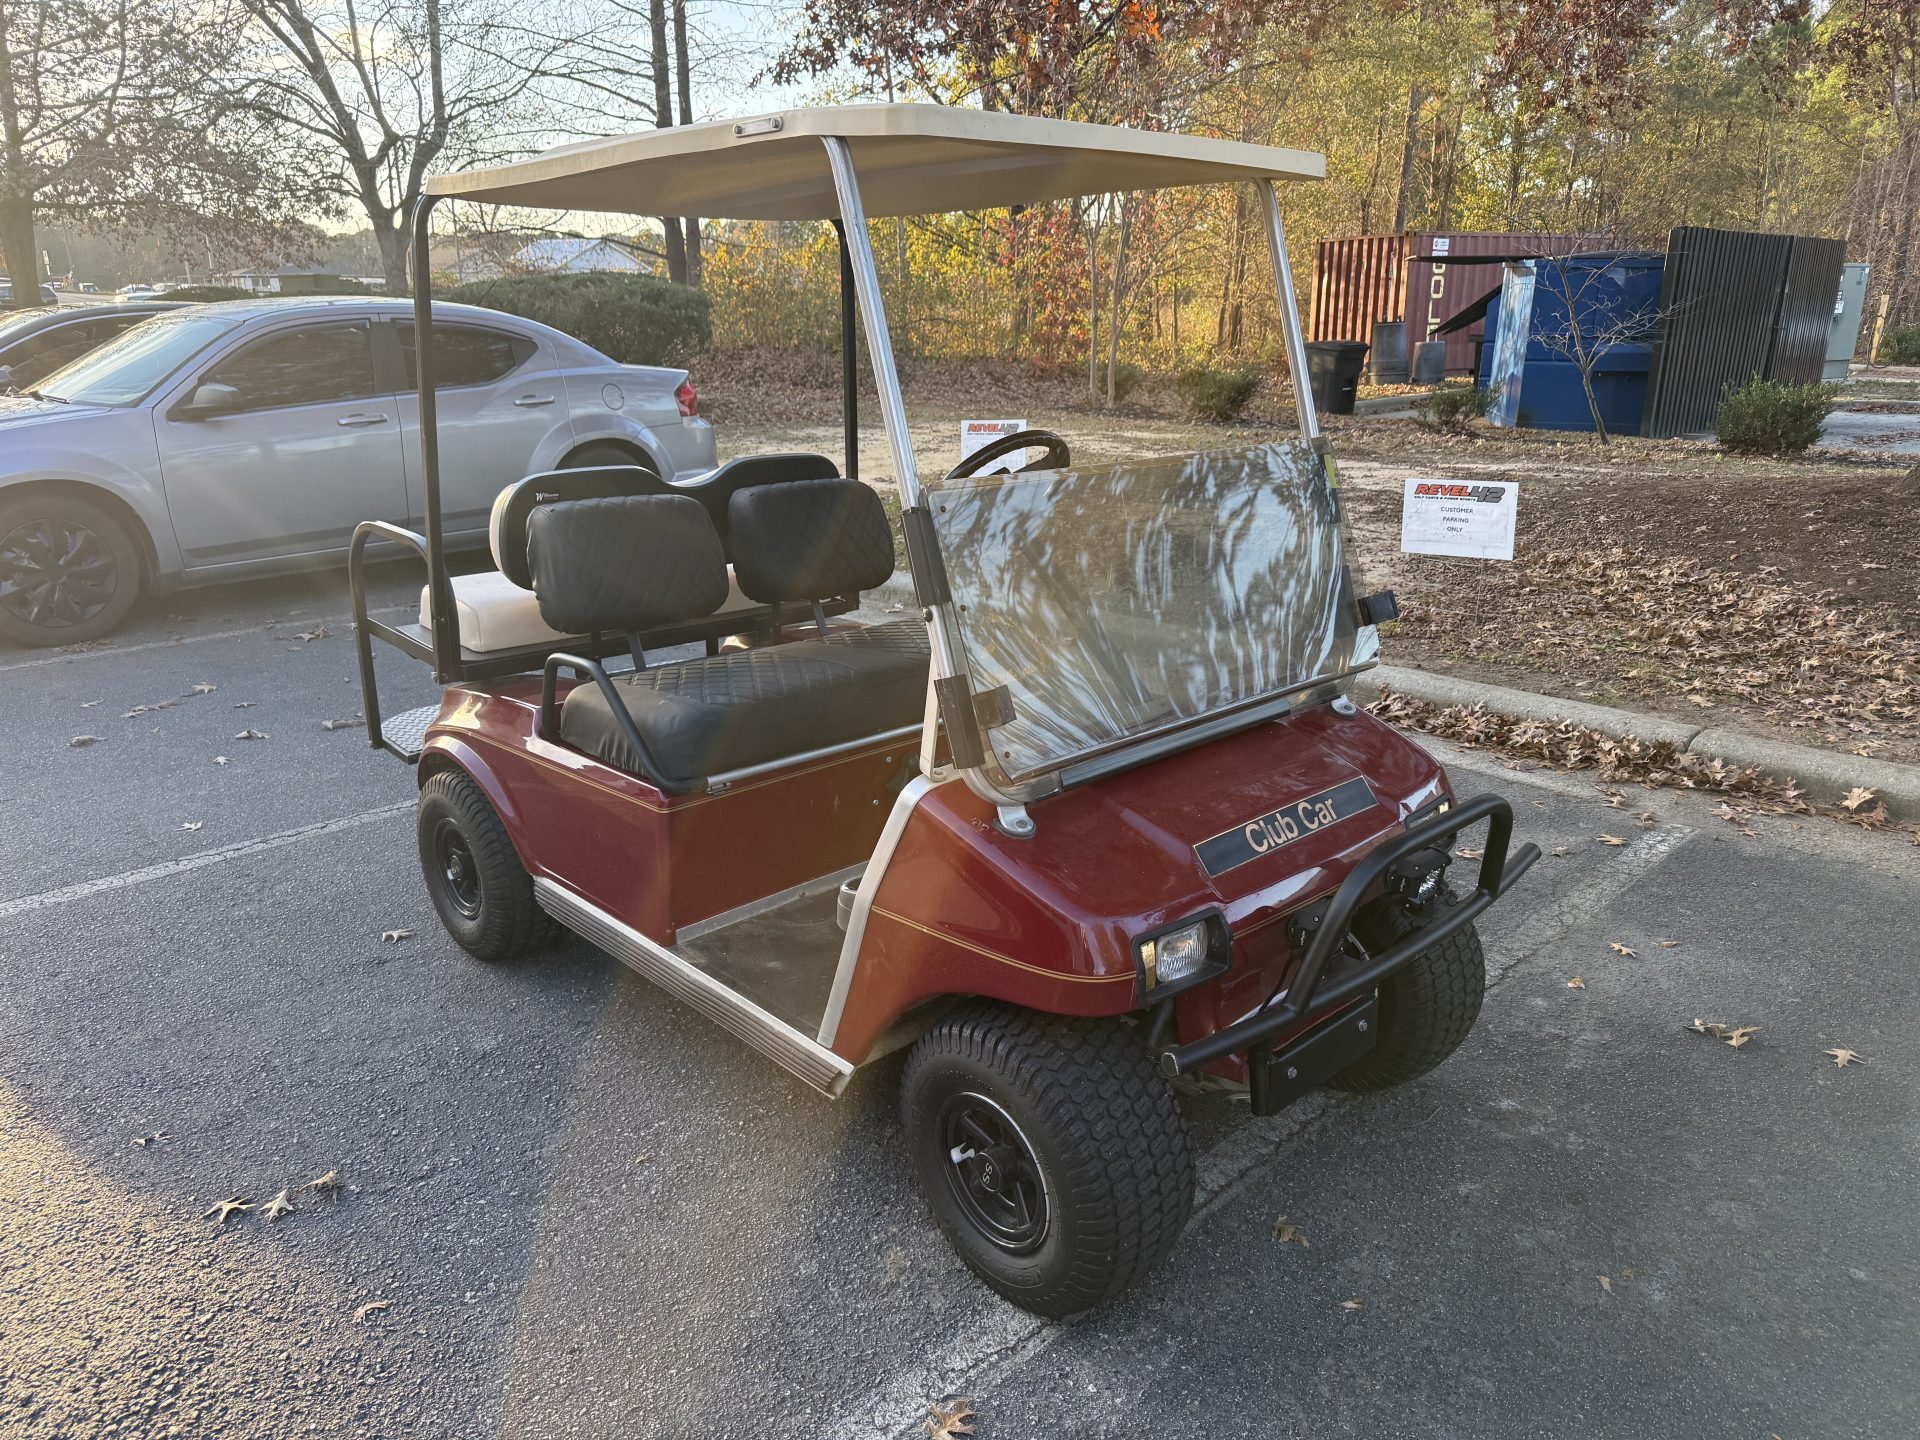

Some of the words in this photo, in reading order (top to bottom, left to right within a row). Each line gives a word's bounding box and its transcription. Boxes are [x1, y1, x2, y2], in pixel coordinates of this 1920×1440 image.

[1414, 484, 1506, 504] REVEL42
[1440, 506, 1474, 514] CUSTOMER
[1245, 813, 1299, 853] Club
[1297, 798, 1338, 830] Car
